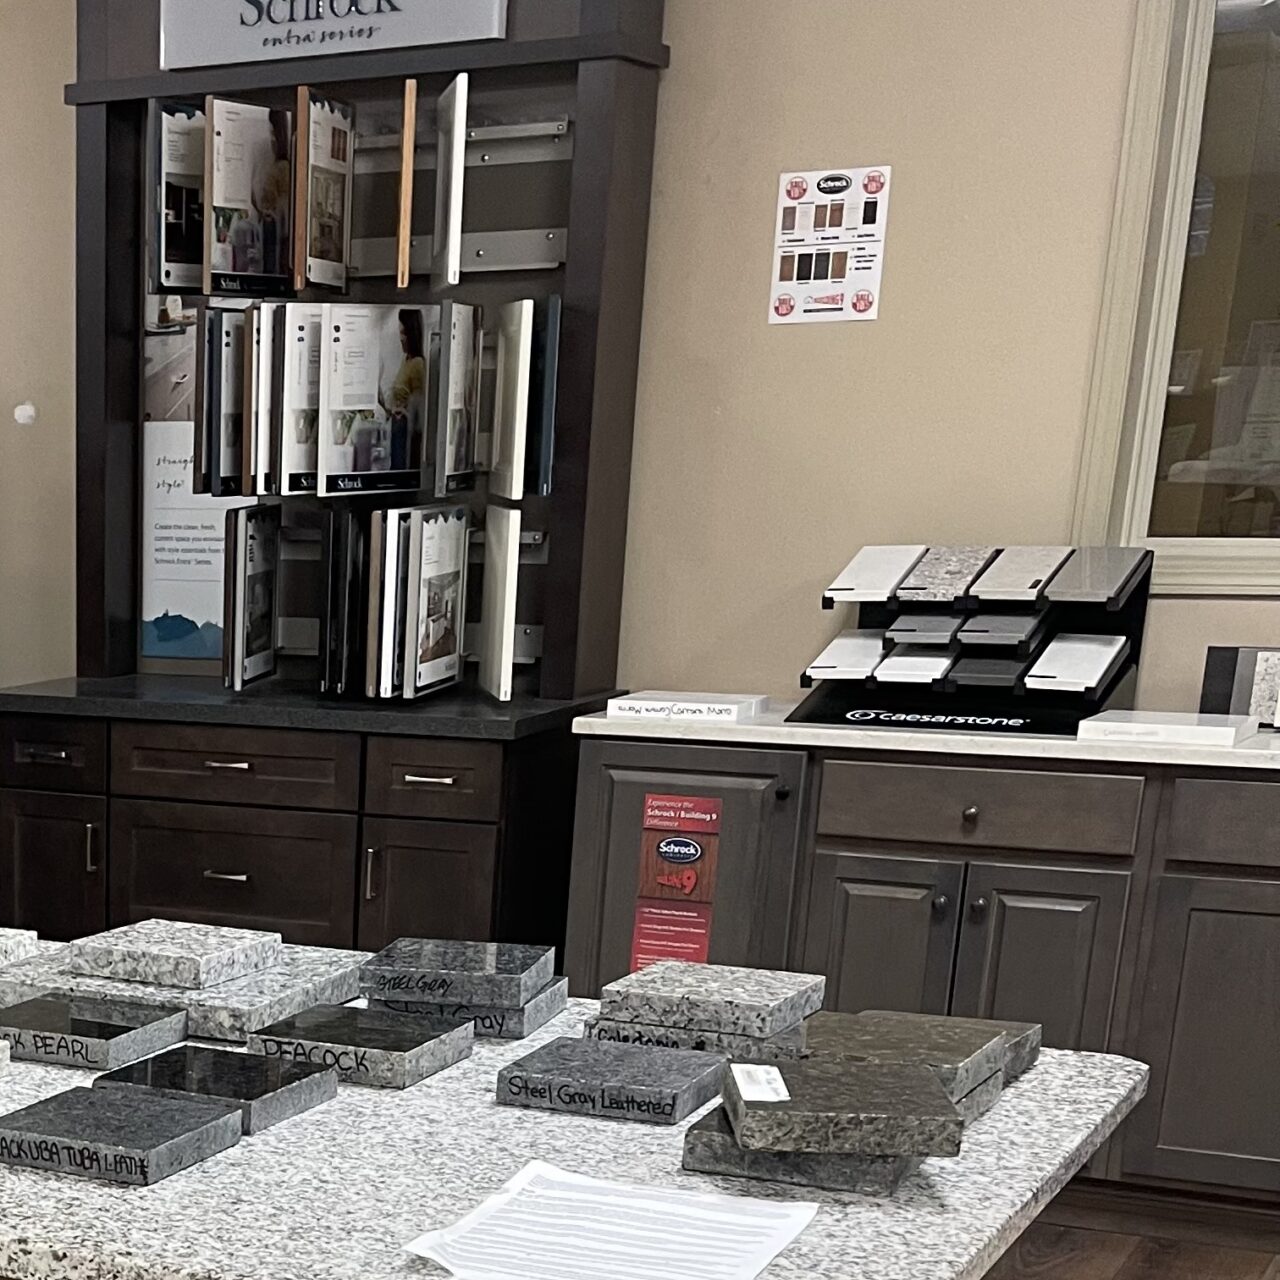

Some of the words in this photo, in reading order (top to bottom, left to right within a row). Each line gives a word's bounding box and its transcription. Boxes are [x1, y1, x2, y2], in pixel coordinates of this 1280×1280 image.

[337, 477, 363, 489] Schrock
[879, 712, 1024, 726] caesarstone
[647, 808, 675, 817] Schrock
[680, 810, 711, 822] Building
[659, 842, 697, 854] Schrock
[376, 974, 415, 991] STEEL
[32, 1034, 99, 1064] PEARL
[262, 1038, 369, 1073] PEACOCK
[508, 1075, 553, 1104] Steel
[557, 1084, 597, 1110] Gray
[600, 1089, 677, 1117] Leathered
[28, 1139, 61, 1165] UBA
[60, 1146, 102, 1172] TUBA
